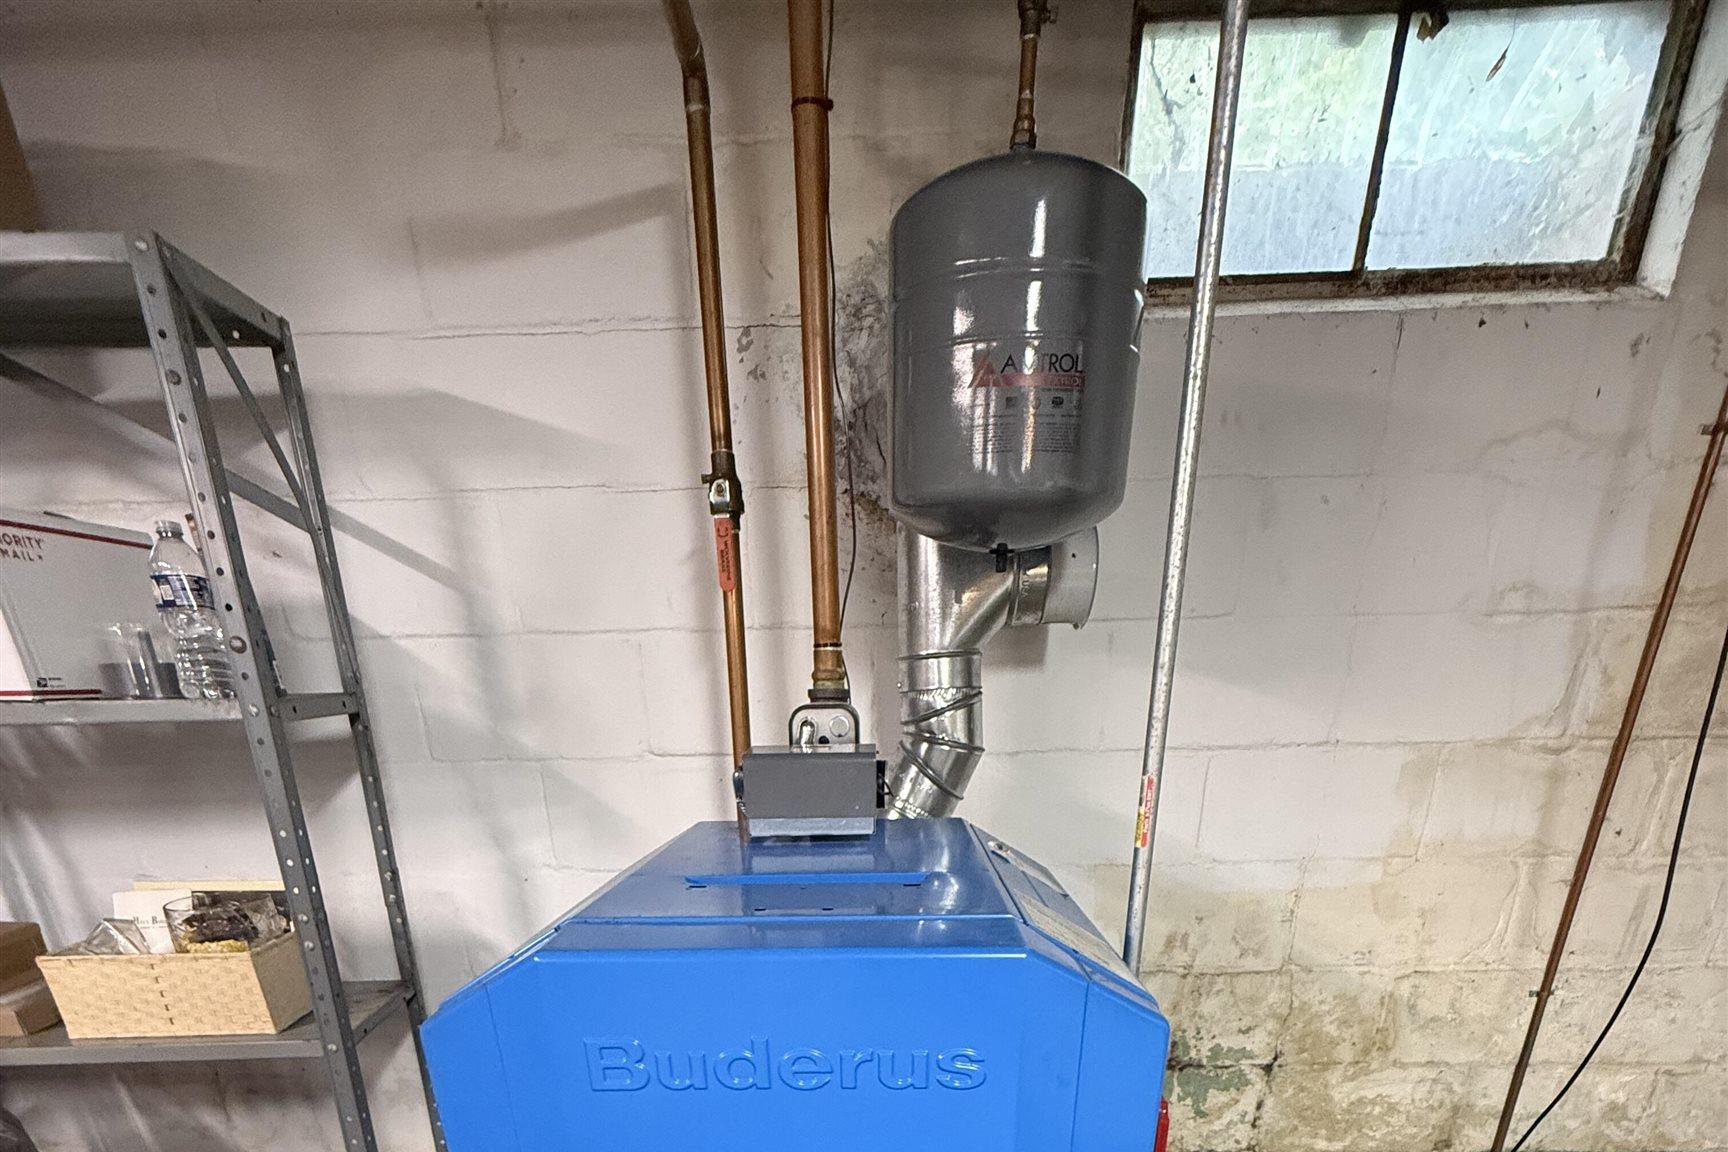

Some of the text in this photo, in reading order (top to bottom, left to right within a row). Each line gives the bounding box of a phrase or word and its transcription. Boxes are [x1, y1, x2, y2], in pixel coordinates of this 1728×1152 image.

[1000, 353, 1083, 374] ATROL
[0, 532, 43, 549] ORITY
[583, 1034, 988, 1092] Buderus
